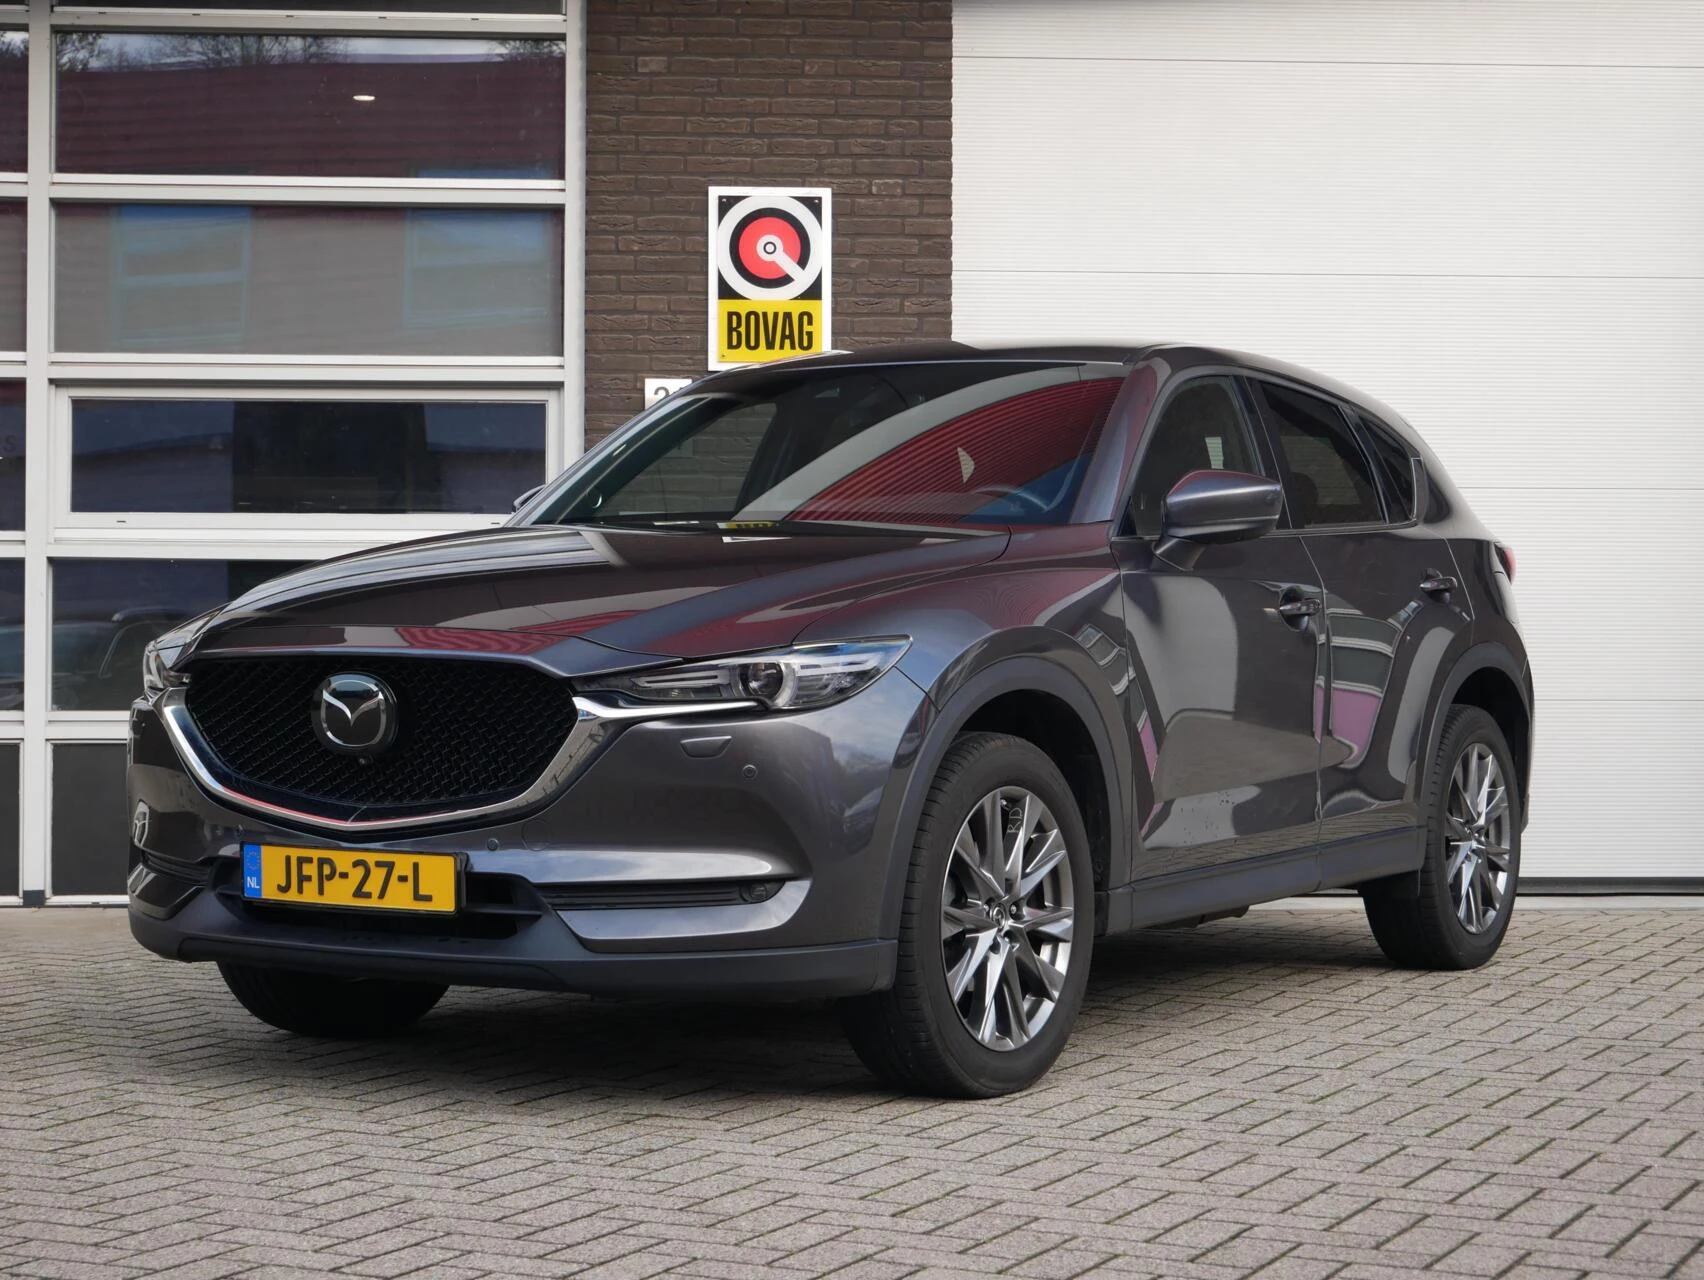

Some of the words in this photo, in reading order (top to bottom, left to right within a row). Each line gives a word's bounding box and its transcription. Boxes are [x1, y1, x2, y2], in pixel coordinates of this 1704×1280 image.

[726, 310, 813, 351] BOVAG
[247, 876, 260, 889] NL
[276, 854, 433, 902] JFP-27-L
